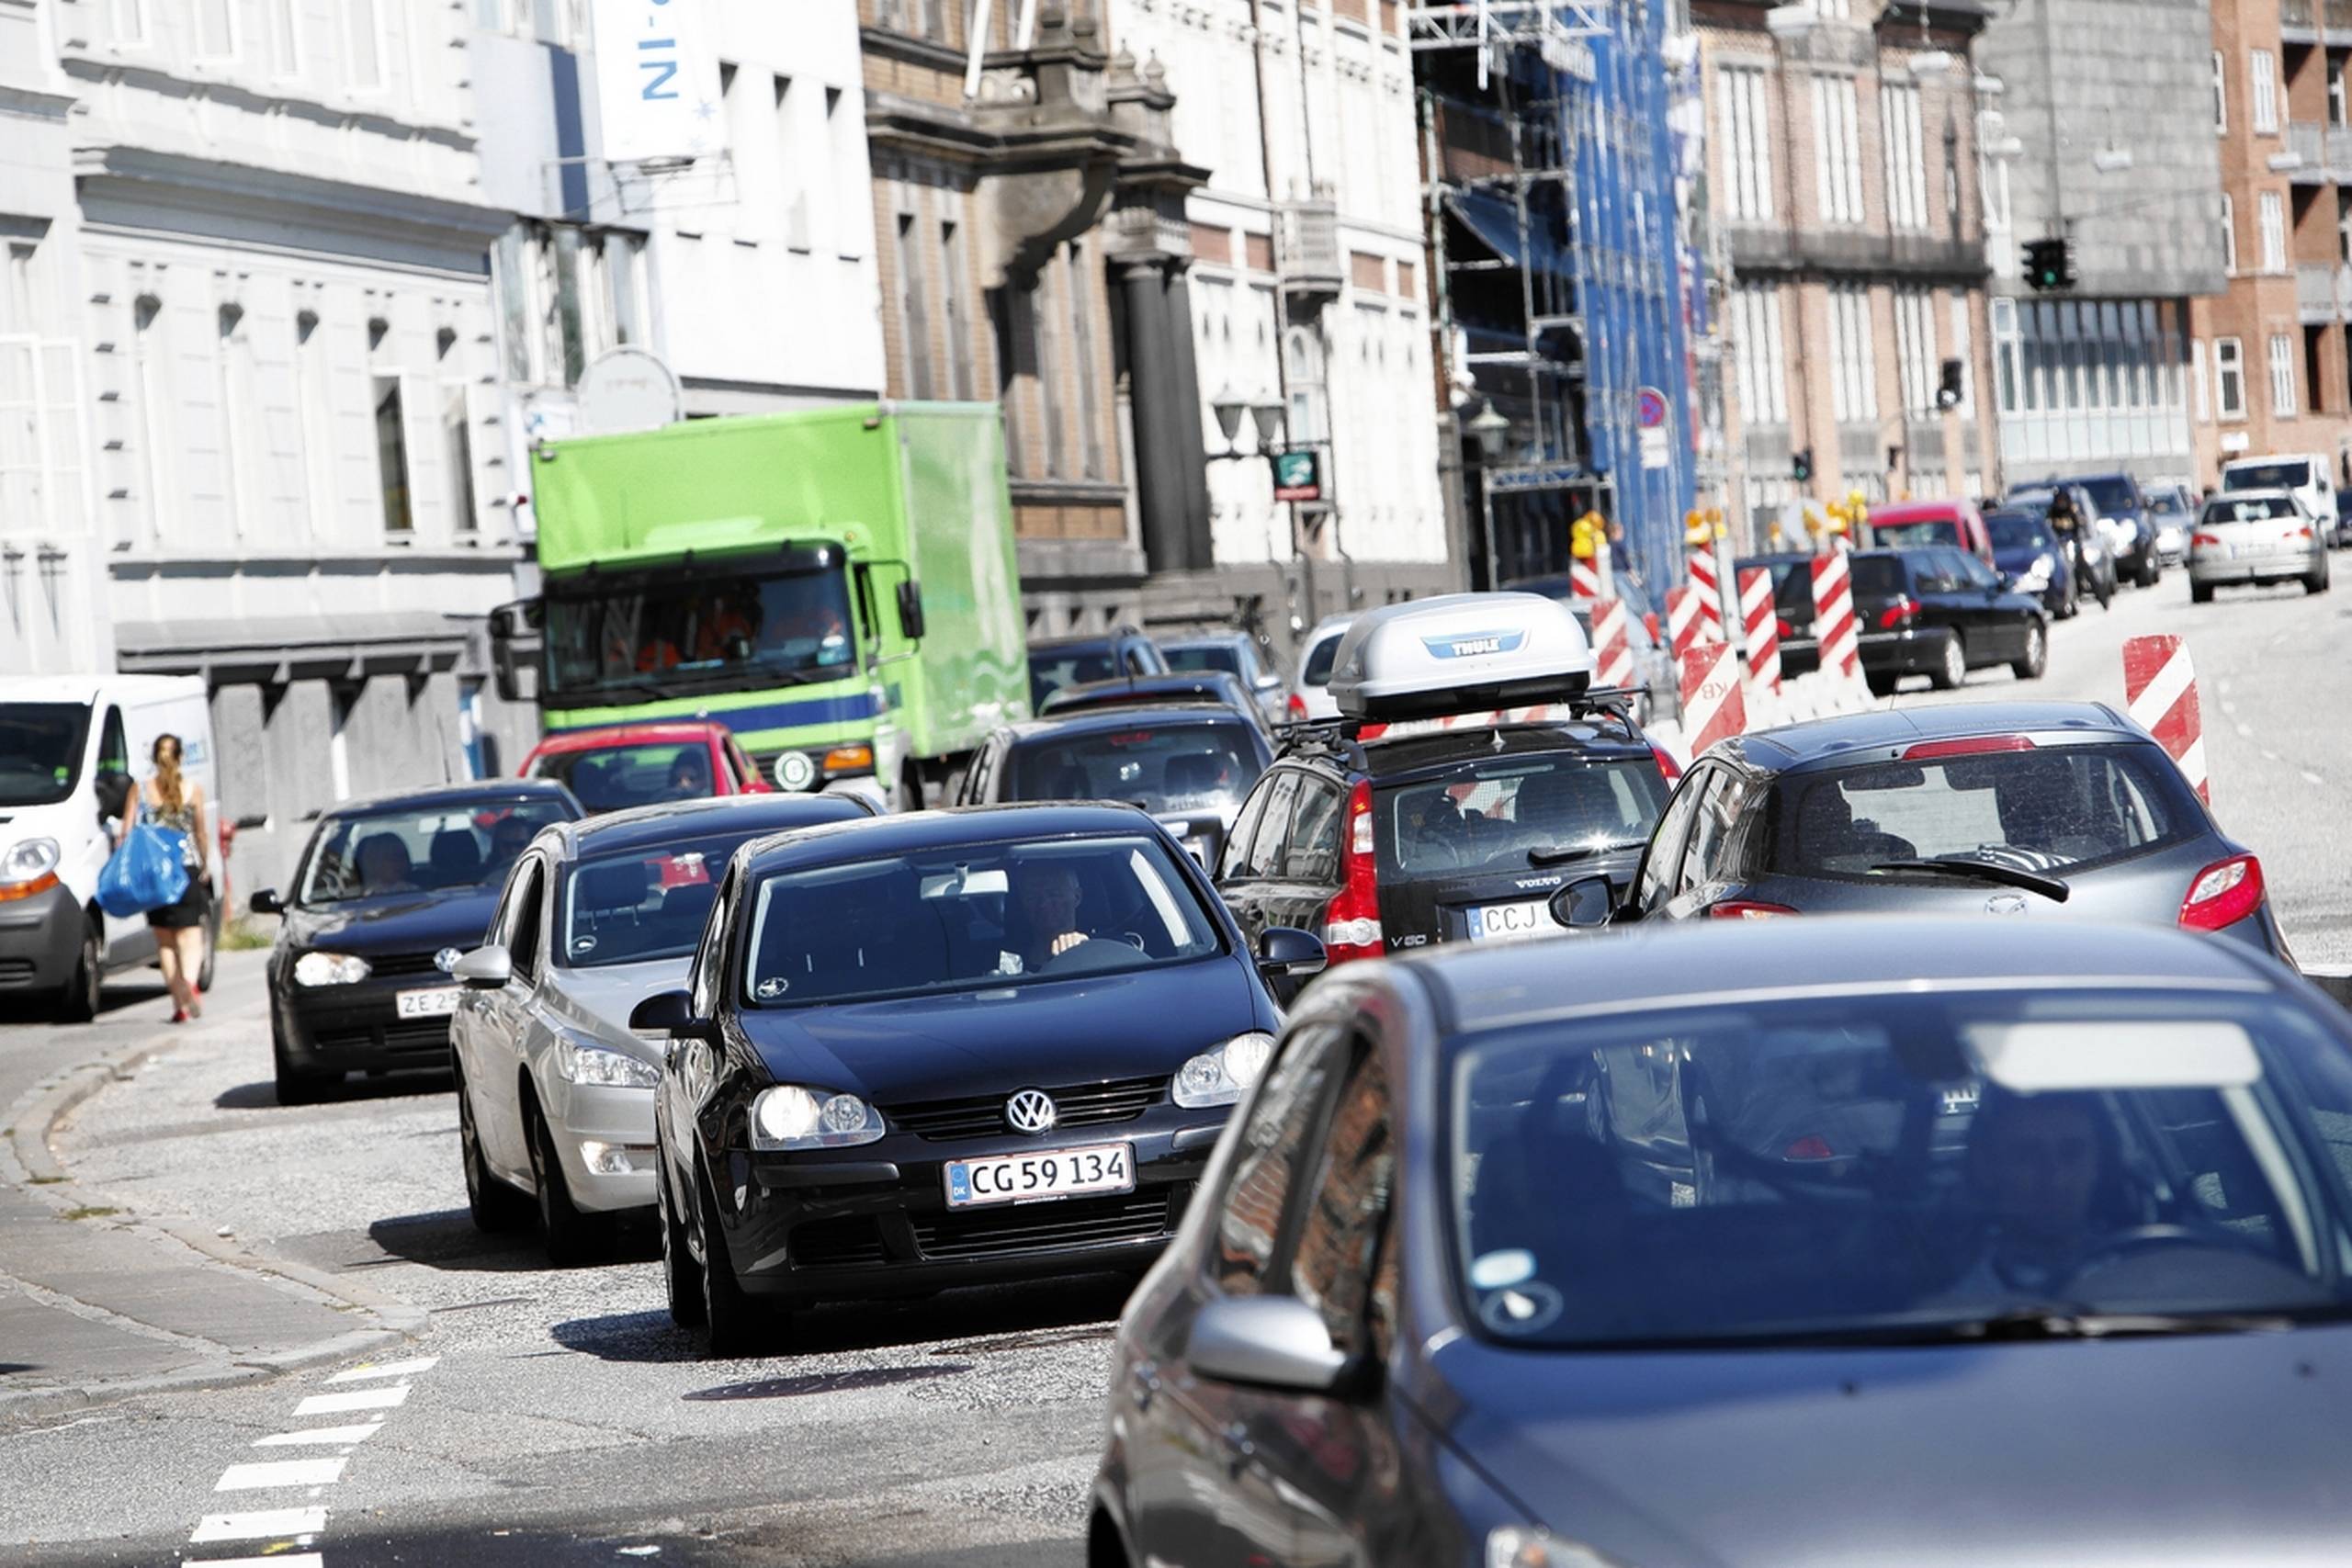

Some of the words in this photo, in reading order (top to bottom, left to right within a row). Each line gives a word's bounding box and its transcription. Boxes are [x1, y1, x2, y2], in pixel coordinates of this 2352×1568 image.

[1452, 637, 1499, 657] THULE
[1515, 876, 1562, 889] VOLVO
[1487, 905, 1536, 932] CCJ
[403, 994, 430, 1013] ZE
[971, 1164, 1014, 1194] CG
[1022, 1159, 1058, 1190] 59
[1069, 1152, 1125, 1185] 134
